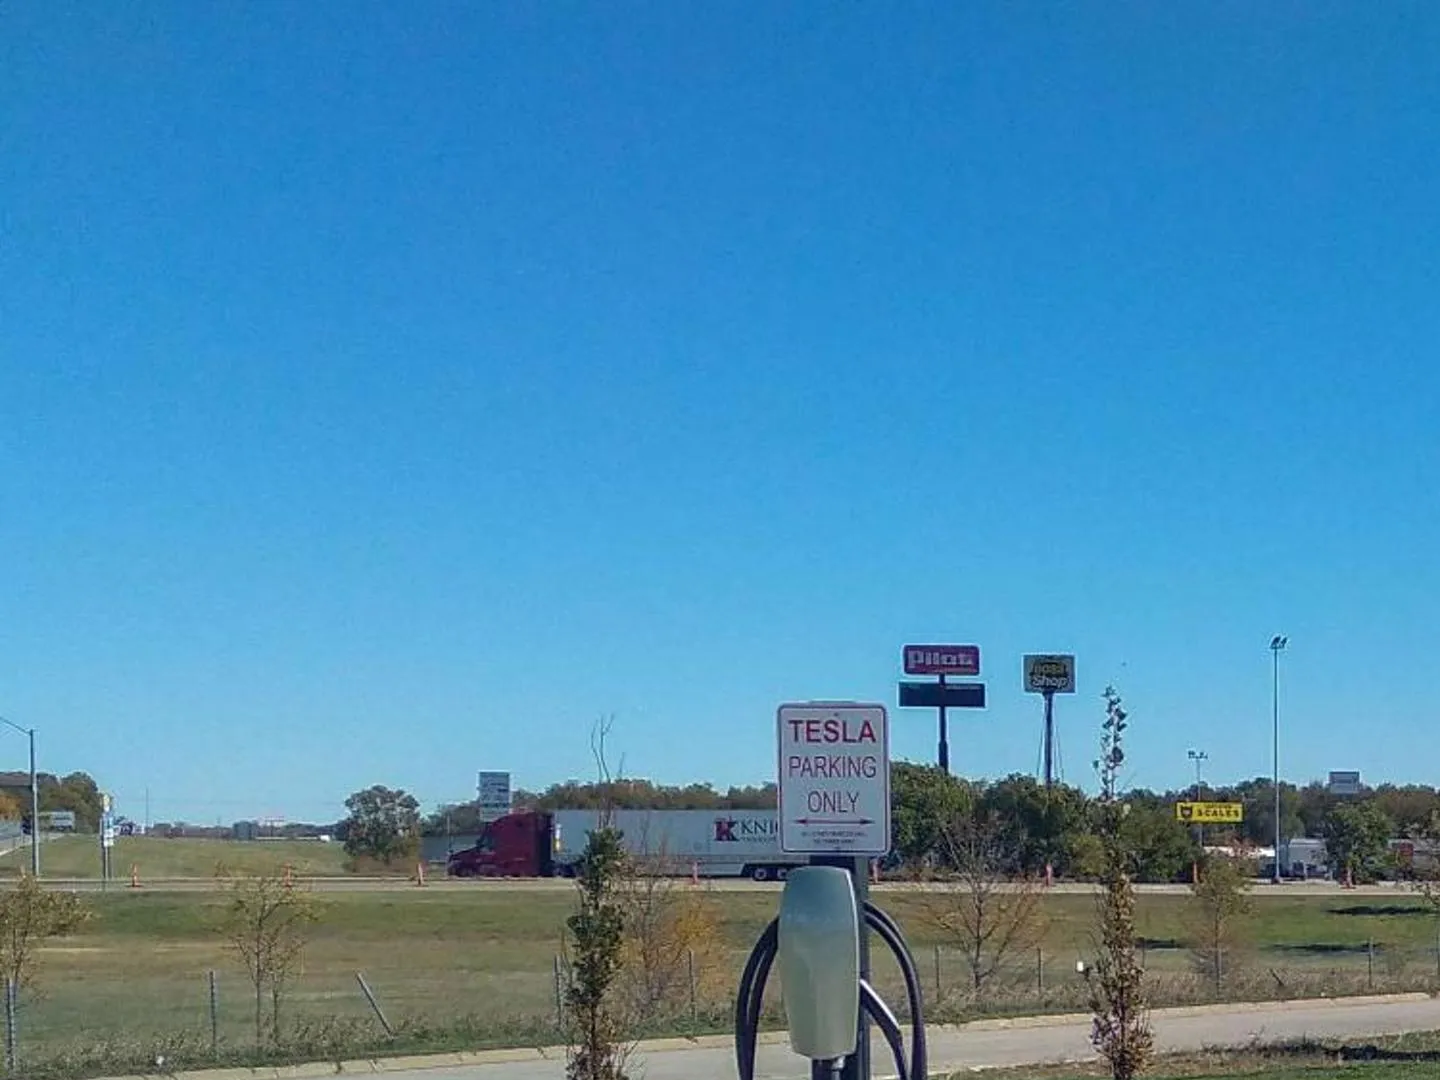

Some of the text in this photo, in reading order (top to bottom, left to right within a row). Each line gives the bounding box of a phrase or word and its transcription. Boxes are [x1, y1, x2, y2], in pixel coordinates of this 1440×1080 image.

[788, 719, 877, 743] TESLA
[788, 756, 877, 779] PARKING
[807, 790, 860, 813] ONLY
